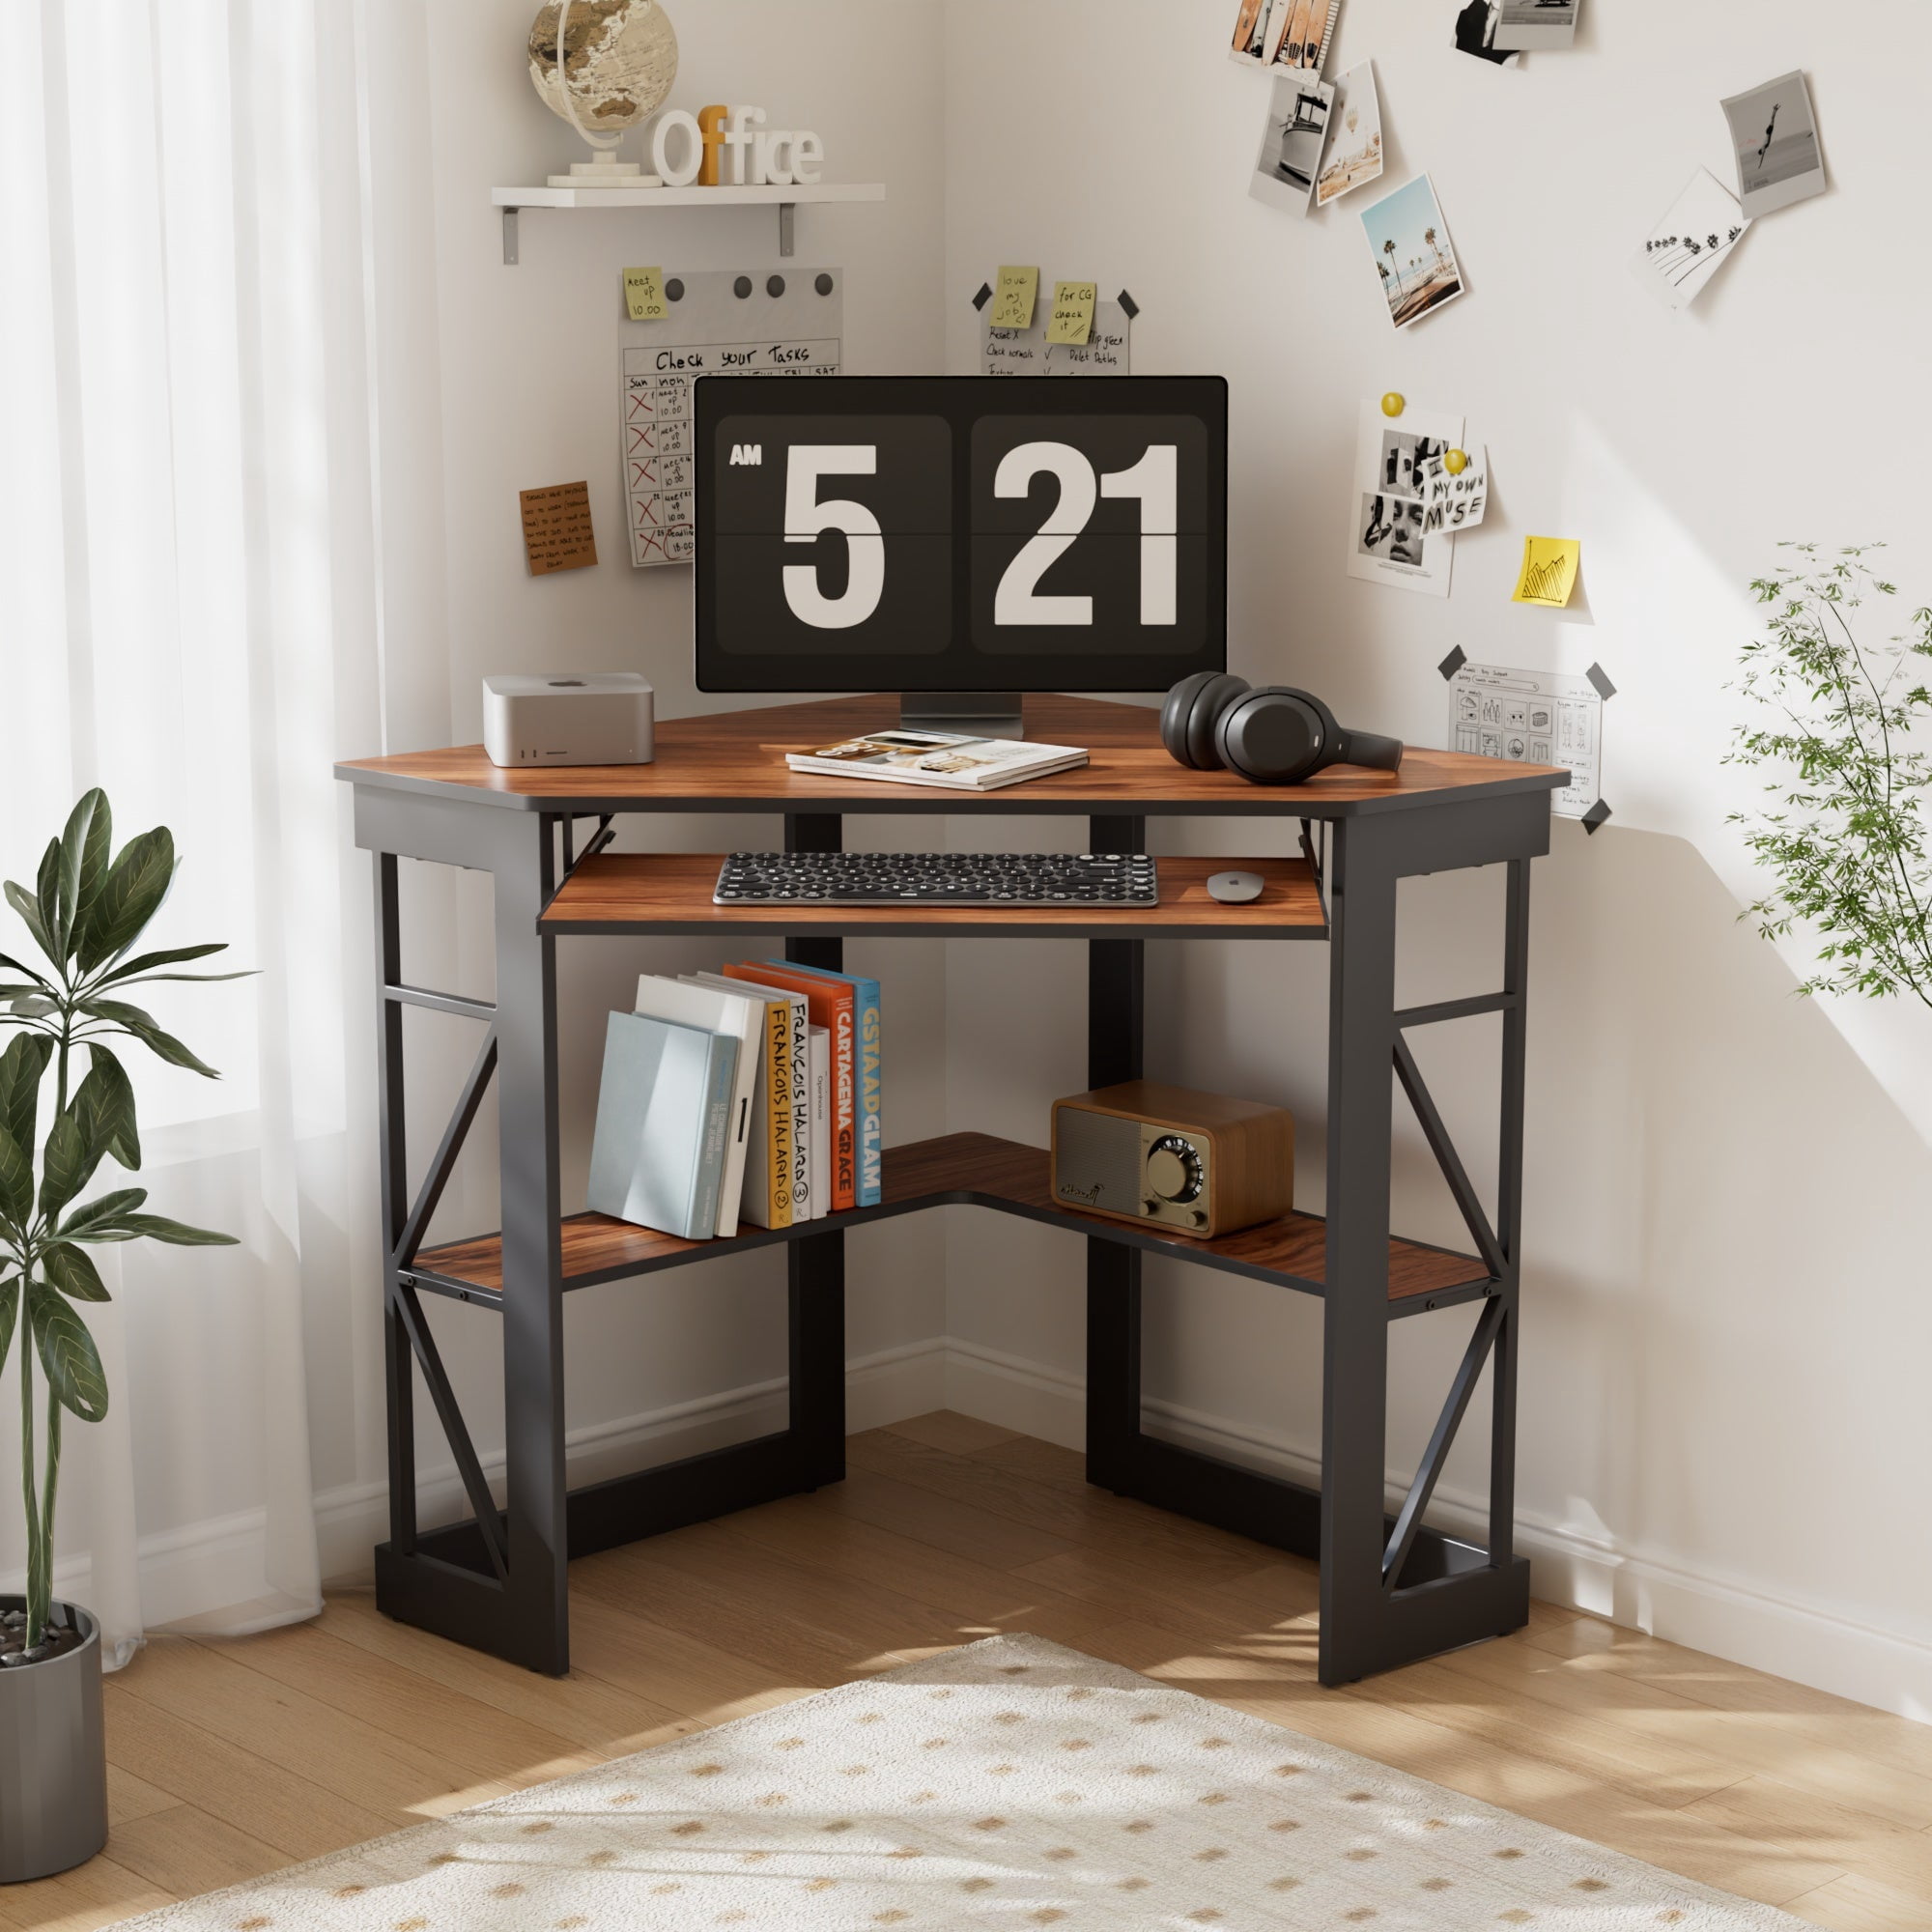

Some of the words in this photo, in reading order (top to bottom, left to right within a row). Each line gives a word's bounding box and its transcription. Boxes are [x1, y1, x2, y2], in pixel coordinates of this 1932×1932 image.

[652, 105, 824, 186] Office
[1003, 275, 1027, 285] love
[1006, 292, 1020, 304] my
[1059, 287, 1075, 303] for
[1079, 289, 1092, 300] CG
[633, 305, 660, 315] 10.00
[1055, 310, 1082, 318] check
[1060, 321, 1068, 330] it
[656, 351, 703, 370] Check
[722, 349, 757, 367] your
[768, 346, 810, 363] Tasks
[986, 343, 1005, 355] Check
[1009, 349, 1033, 358] normals
[629, 377, 648, 388] Sun
[729, 444, 762, 465] AM
[1433, 481, 1451, 501] MY
[1456, 473, 1483, 494] OWN
[1422, 497, 1483, 535] MUSE
[782, 444, 885, 629] 5
[994, 441, 1178, 625] 21
[773, 1009, 788, 1106] FRANÇOIS
[791, 1003, 805, 1100] FRANÇOIS
[837, 1011, 852, 1130] CARTAGENA
[774, 1111, 788, 1188] HALARD
[793, 1104, 808, 1181] HALARD
